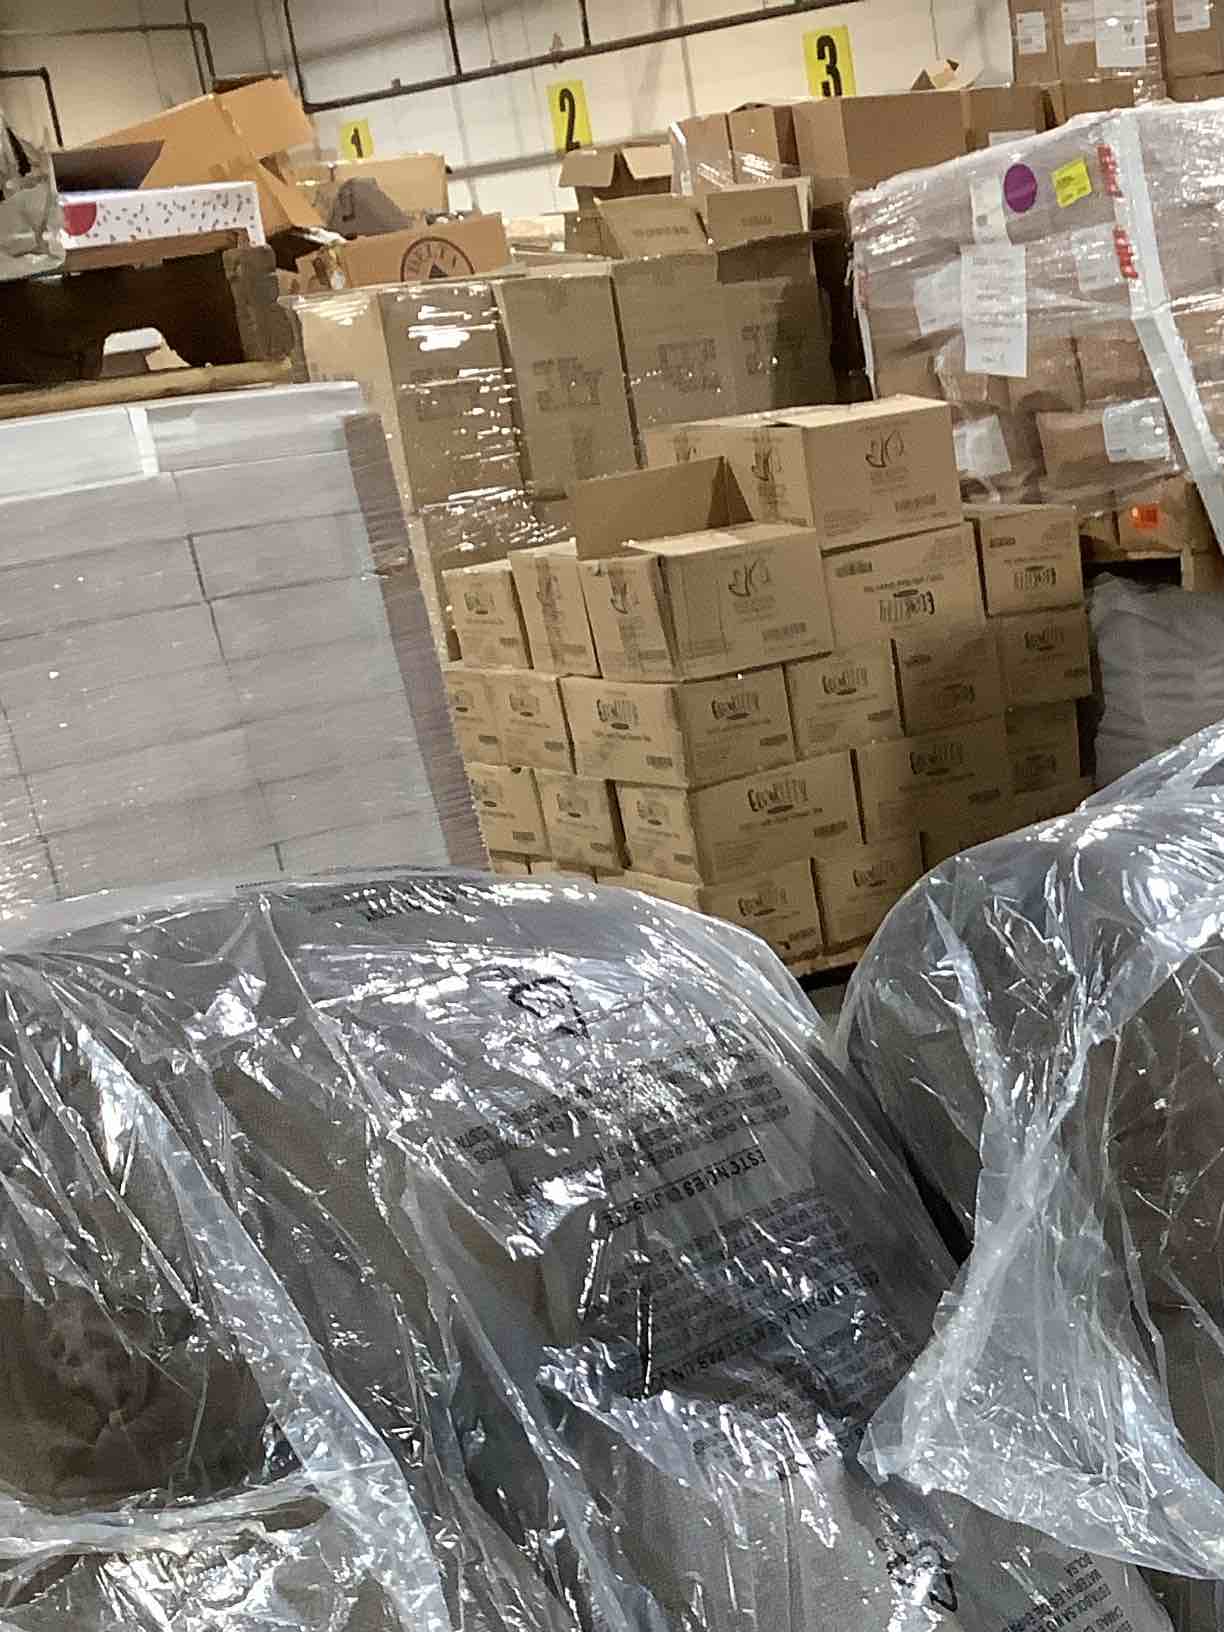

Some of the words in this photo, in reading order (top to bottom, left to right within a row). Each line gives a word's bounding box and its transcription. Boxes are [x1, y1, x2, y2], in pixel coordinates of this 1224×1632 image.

[816, 34, 842, 97] 3
[351, 127, 363, 159] 1
[559, 88, 581, 152] 2
